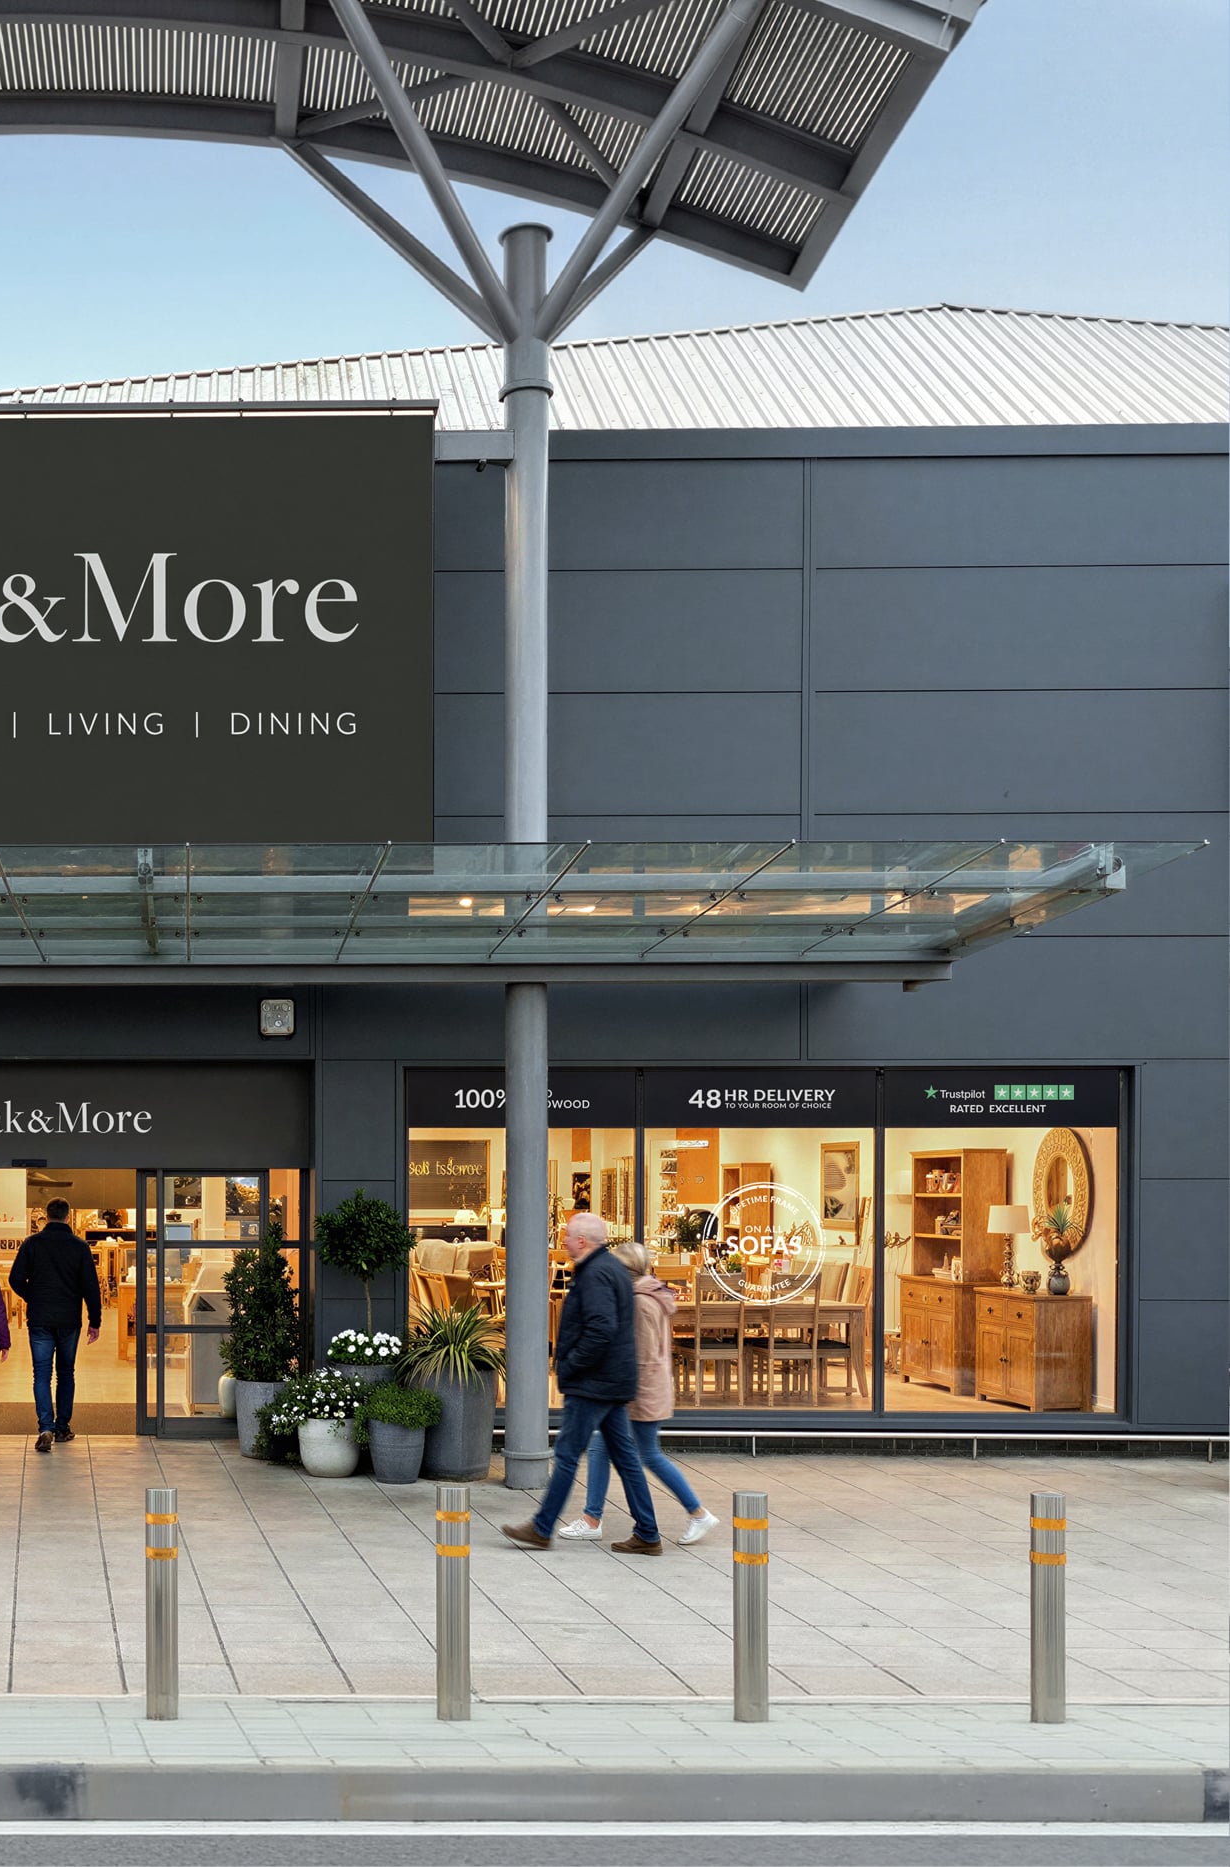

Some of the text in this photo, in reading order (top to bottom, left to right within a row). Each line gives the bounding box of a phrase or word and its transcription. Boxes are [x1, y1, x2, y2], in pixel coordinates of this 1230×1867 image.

[48, 712, 164, 736] LIVING
[230, 712, 358, 736] DINING
[688, 1089, 836, 1109] 48 HR DELIVERY
[939, 1089, 986, 1100] Trustpilot
[949, 1104, 1047, 1113] RATED EXCELLENT
[730, 1195, 800, 1216] LIFETIME FRAME
[744, 1225, 782, 1233] ON ALL
[726, 1235, 803, 1255] SOFAS
[738, 1278, 792, 1293] GUARANTEE
